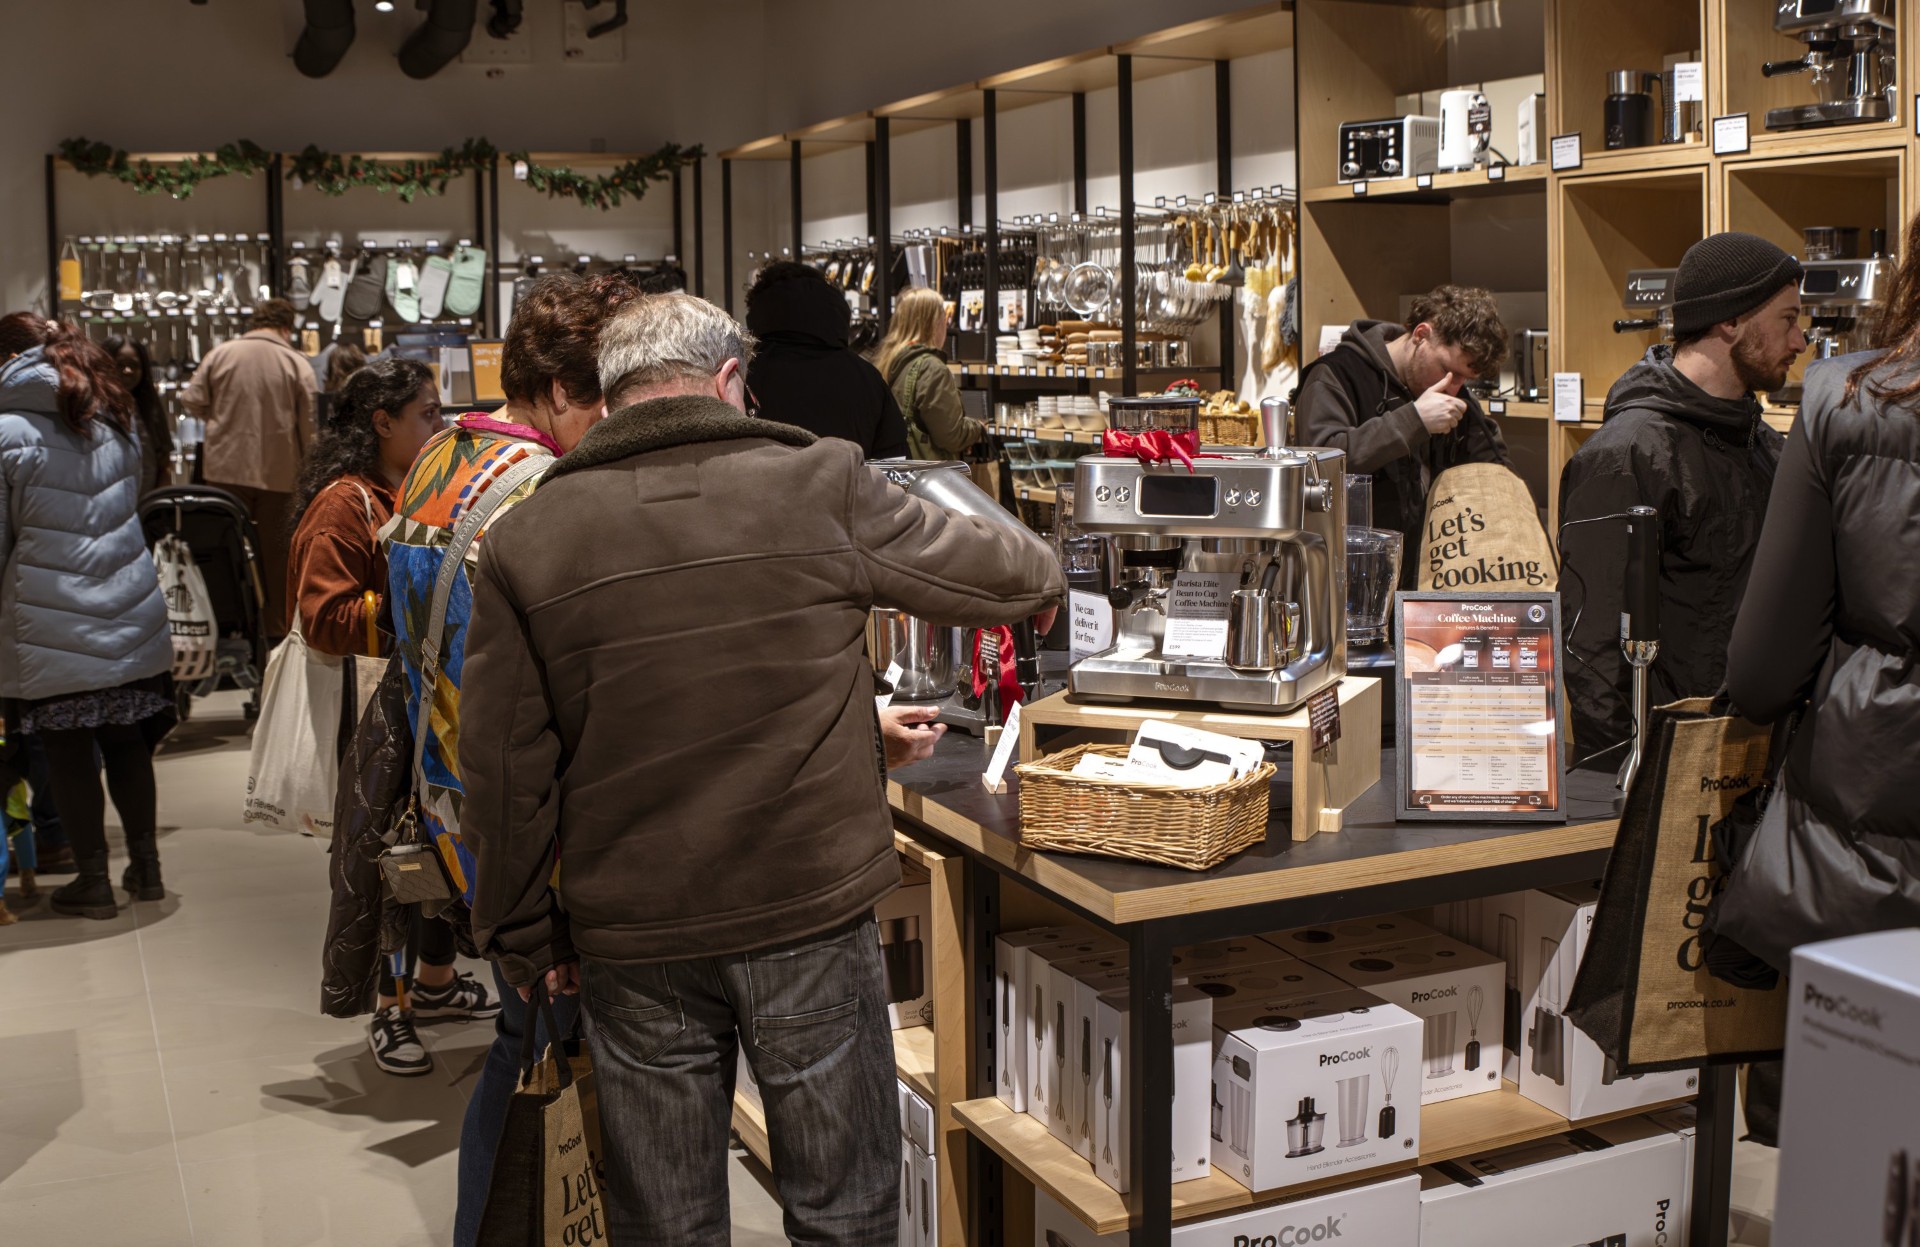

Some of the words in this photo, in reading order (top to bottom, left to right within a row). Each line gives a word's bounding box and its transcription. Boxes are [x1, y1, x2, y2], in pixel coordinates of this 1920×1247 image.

[1429, 508, 1485, 544] Let's
[1430, 536, 1469, 572] get
[1432, 556, 1548, 590] cooking.
[1203, 590, 1218, 599] Cup
[1074, 602, 1084, 613] We
[1084, 606, 1094, 615] can
[1437, 613, 1470, 623] Coffee
[1473, 613, 1517, 623] Machine
[1074, 617, 1093, 629] deliver
[1075, 631, 1083, 640] for
[1084, 633, 1095, 644] free
[1701, 775, 1750, 792] ProCook
[1412, 985, 1458, 1003] ProCook
[1667, 998, 1736, 1011] procook.co.uk
[1804, 982, 1883, 1032] ProCook
[1320, 1047, 1371, 1067] ProCook
[558, 1134, 582, 1158] ProCook
[1306, 1163, 1321, 1172] Hand
[1323, 1159, 1344, 1169] Blender
[1345, 1152, 1376, 1163] Accessories
[1234, 1216, 1342, 1247] ProCook
[1655, 1198, 1670, 1247] ProC
